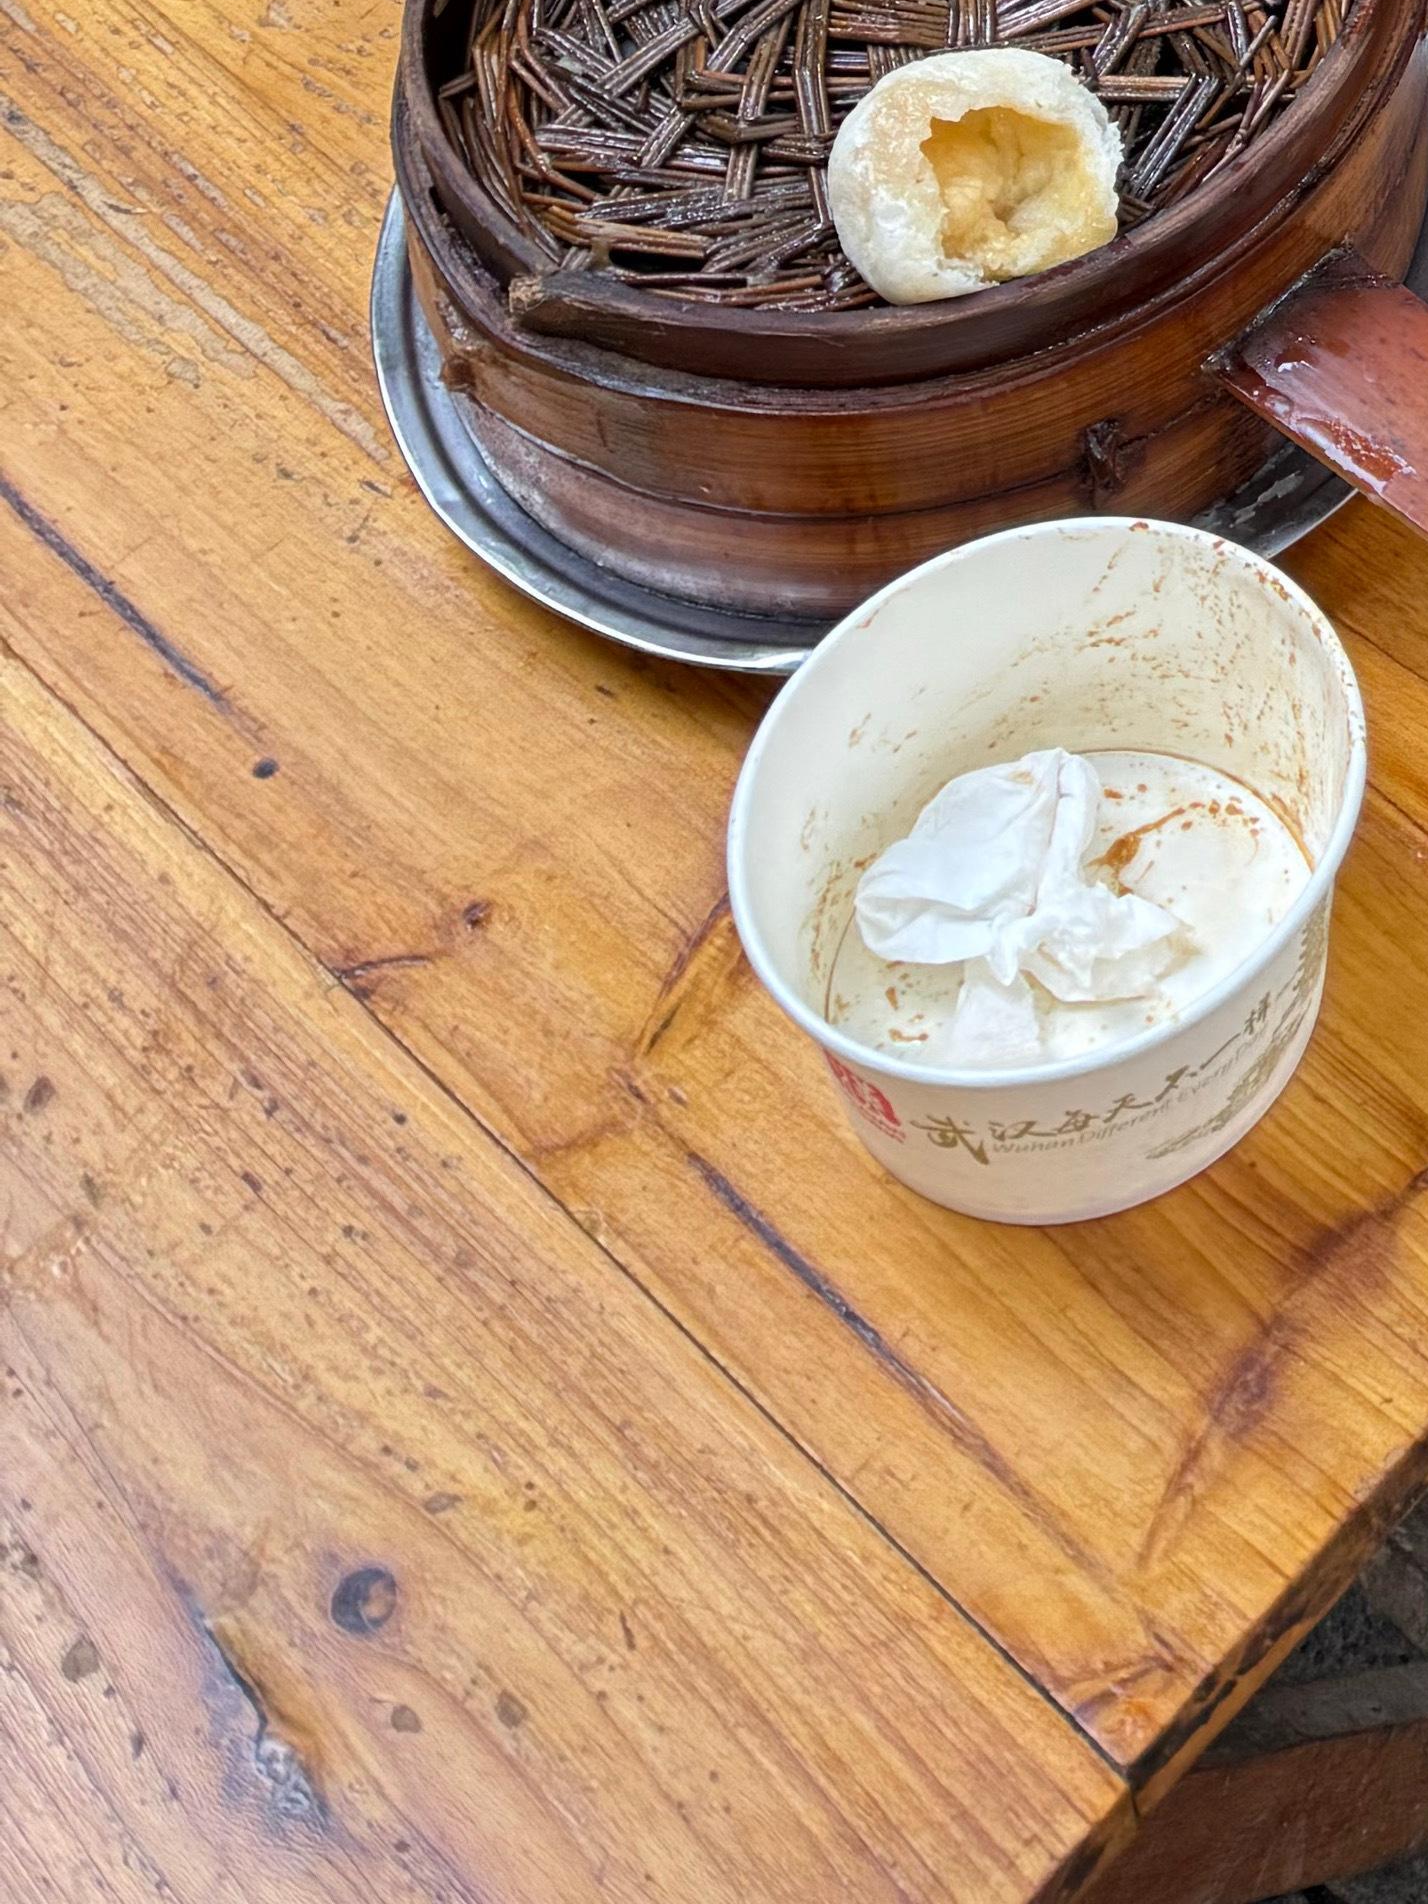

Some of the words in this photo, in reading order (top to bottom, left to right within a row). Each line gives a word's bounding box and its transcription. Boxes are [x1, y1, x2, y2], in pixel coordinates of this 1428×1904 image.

[909, 992, 1271, 1165] 武汉每天不一样
[992, 1136, 1075, 1153] Wuhan
[1079, 1098, 1172, 1145] Different
